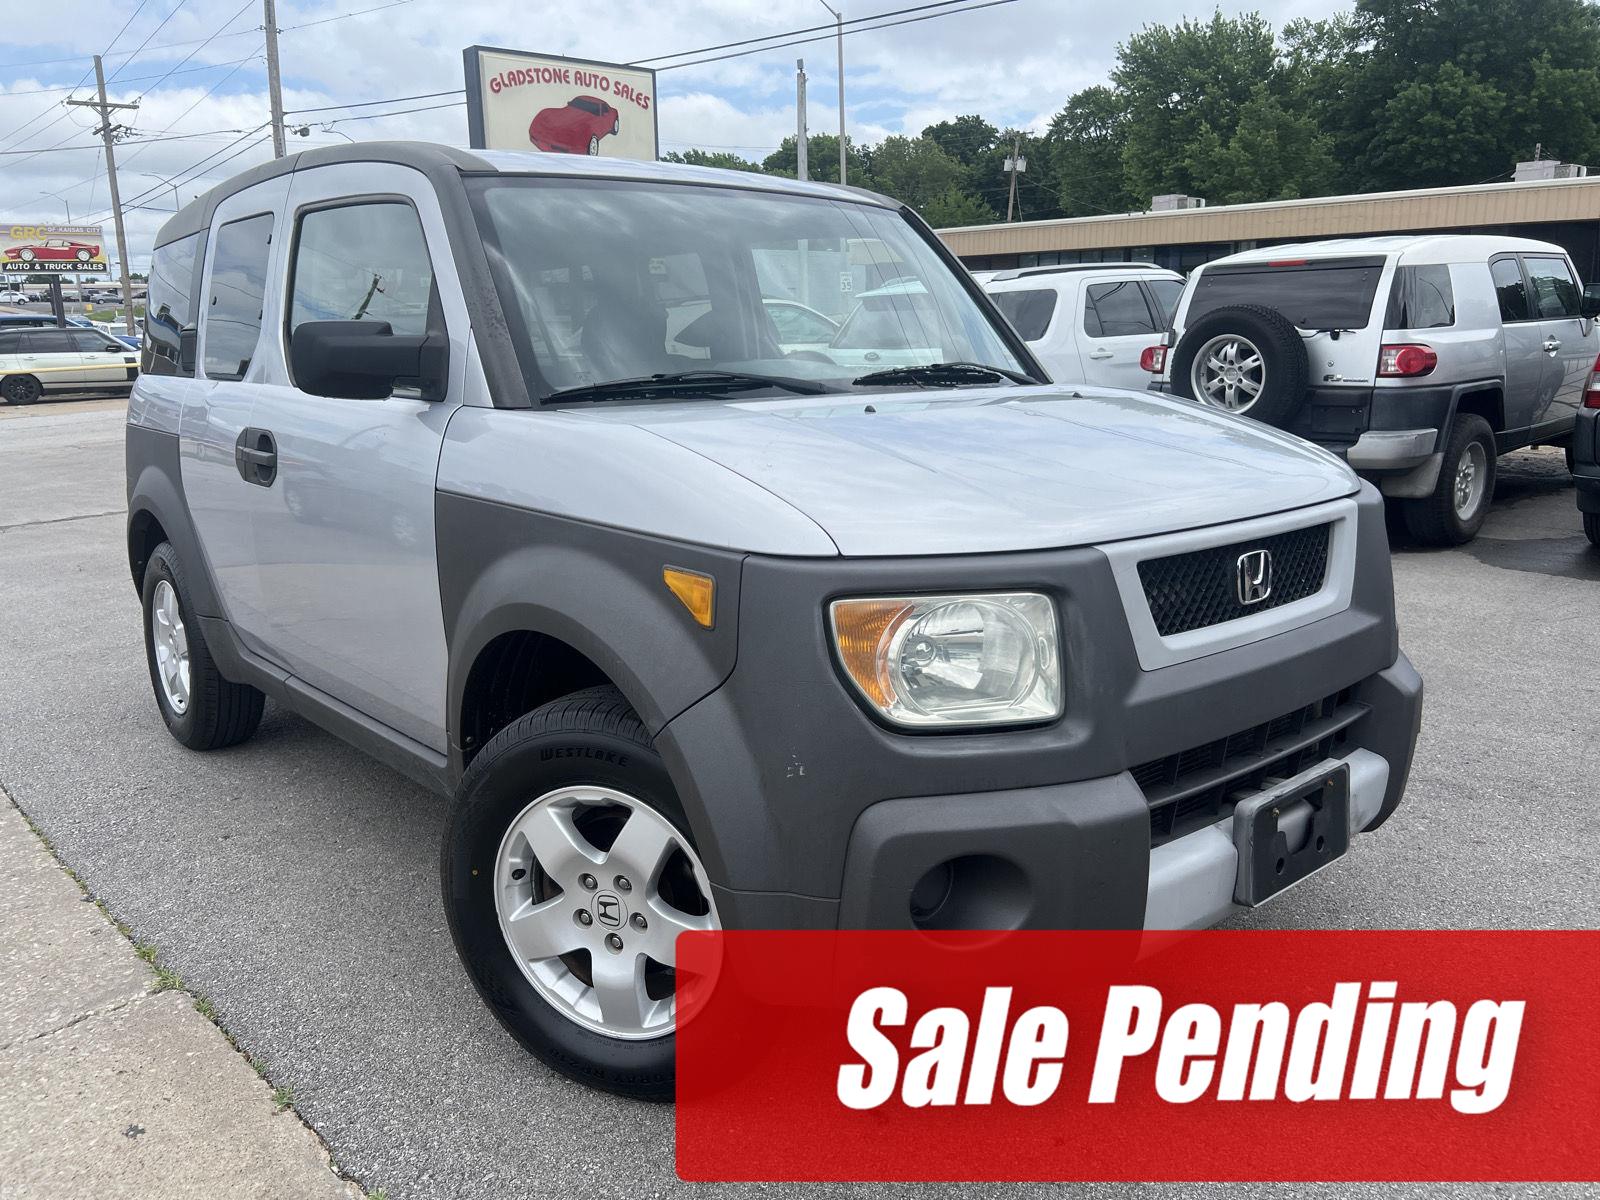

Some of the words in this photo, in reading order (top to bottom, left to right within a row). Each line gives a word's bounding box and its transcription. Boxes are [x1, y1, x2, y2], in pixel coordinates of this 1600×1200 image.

[489, 67, 570, 94] GLADSTONE
[574, 70, 610, 91] AUTO
[613, 80, 650, 110] SALES
[10, 224, 47, 240] GRC
[540, 747, 628, 767] WESTLAKE
